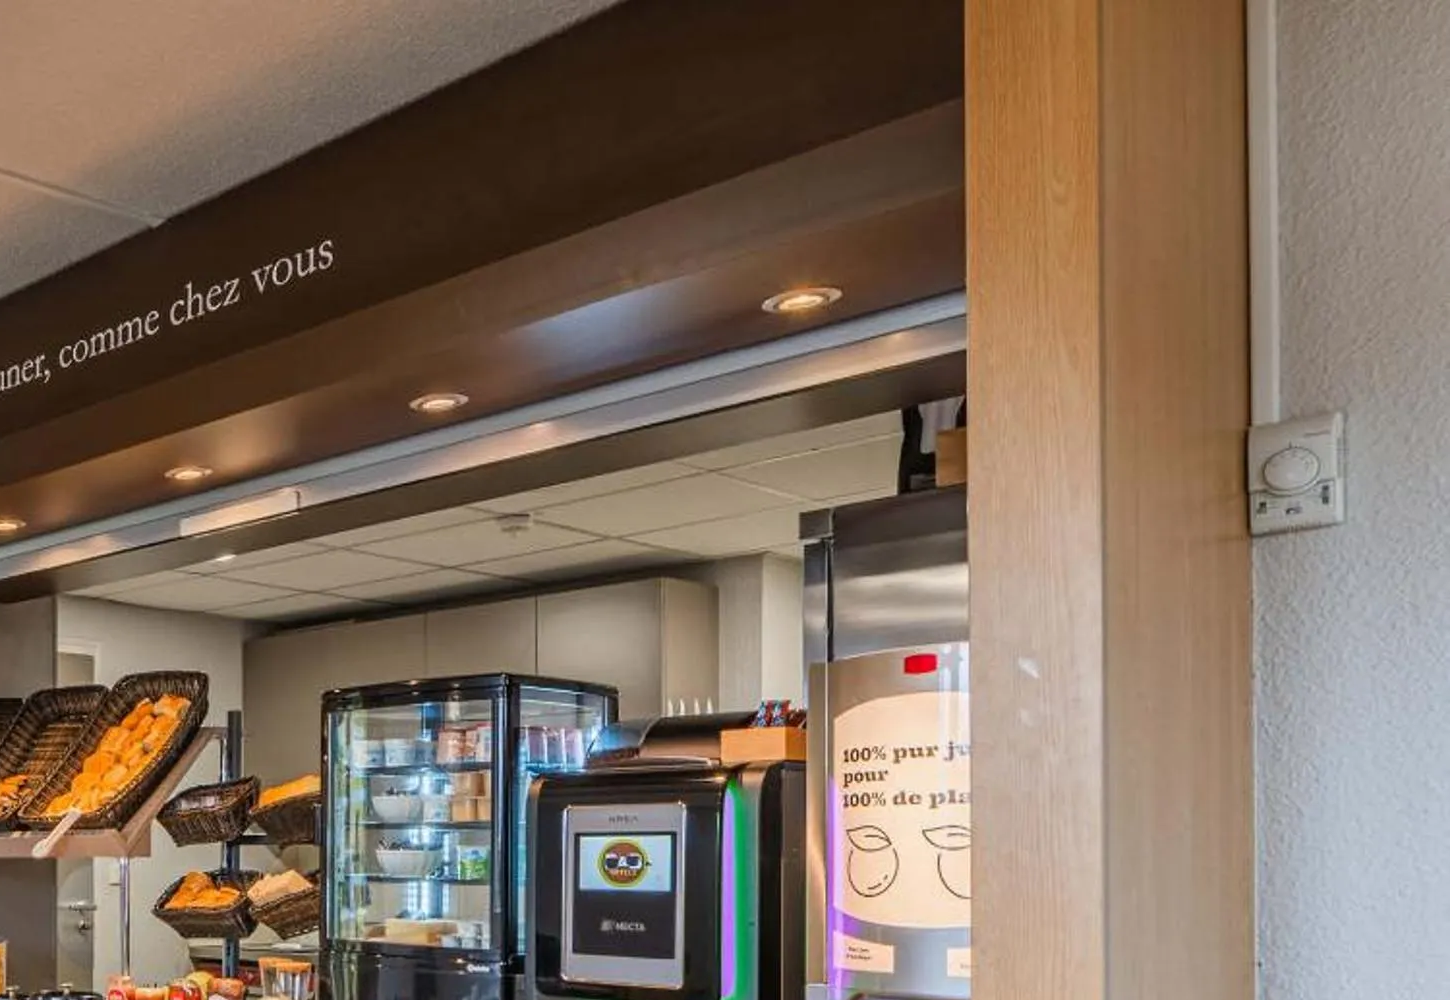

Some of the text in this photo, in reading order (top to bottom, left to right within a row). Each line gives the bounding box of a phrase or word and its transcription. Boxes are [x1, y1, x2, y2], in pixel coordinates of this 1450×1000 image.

[58, 310, 161, 368] comme
[169, 281, 241, 326] chez
[251, 239, 335, 293] vous
[843, 745, 887, 763] 100%
[893, 744, 939, 764] pur
[843, 769, 889, 788] pour
[843, 792, 887, 808] 100%
[892, 790, 923, 806] de
